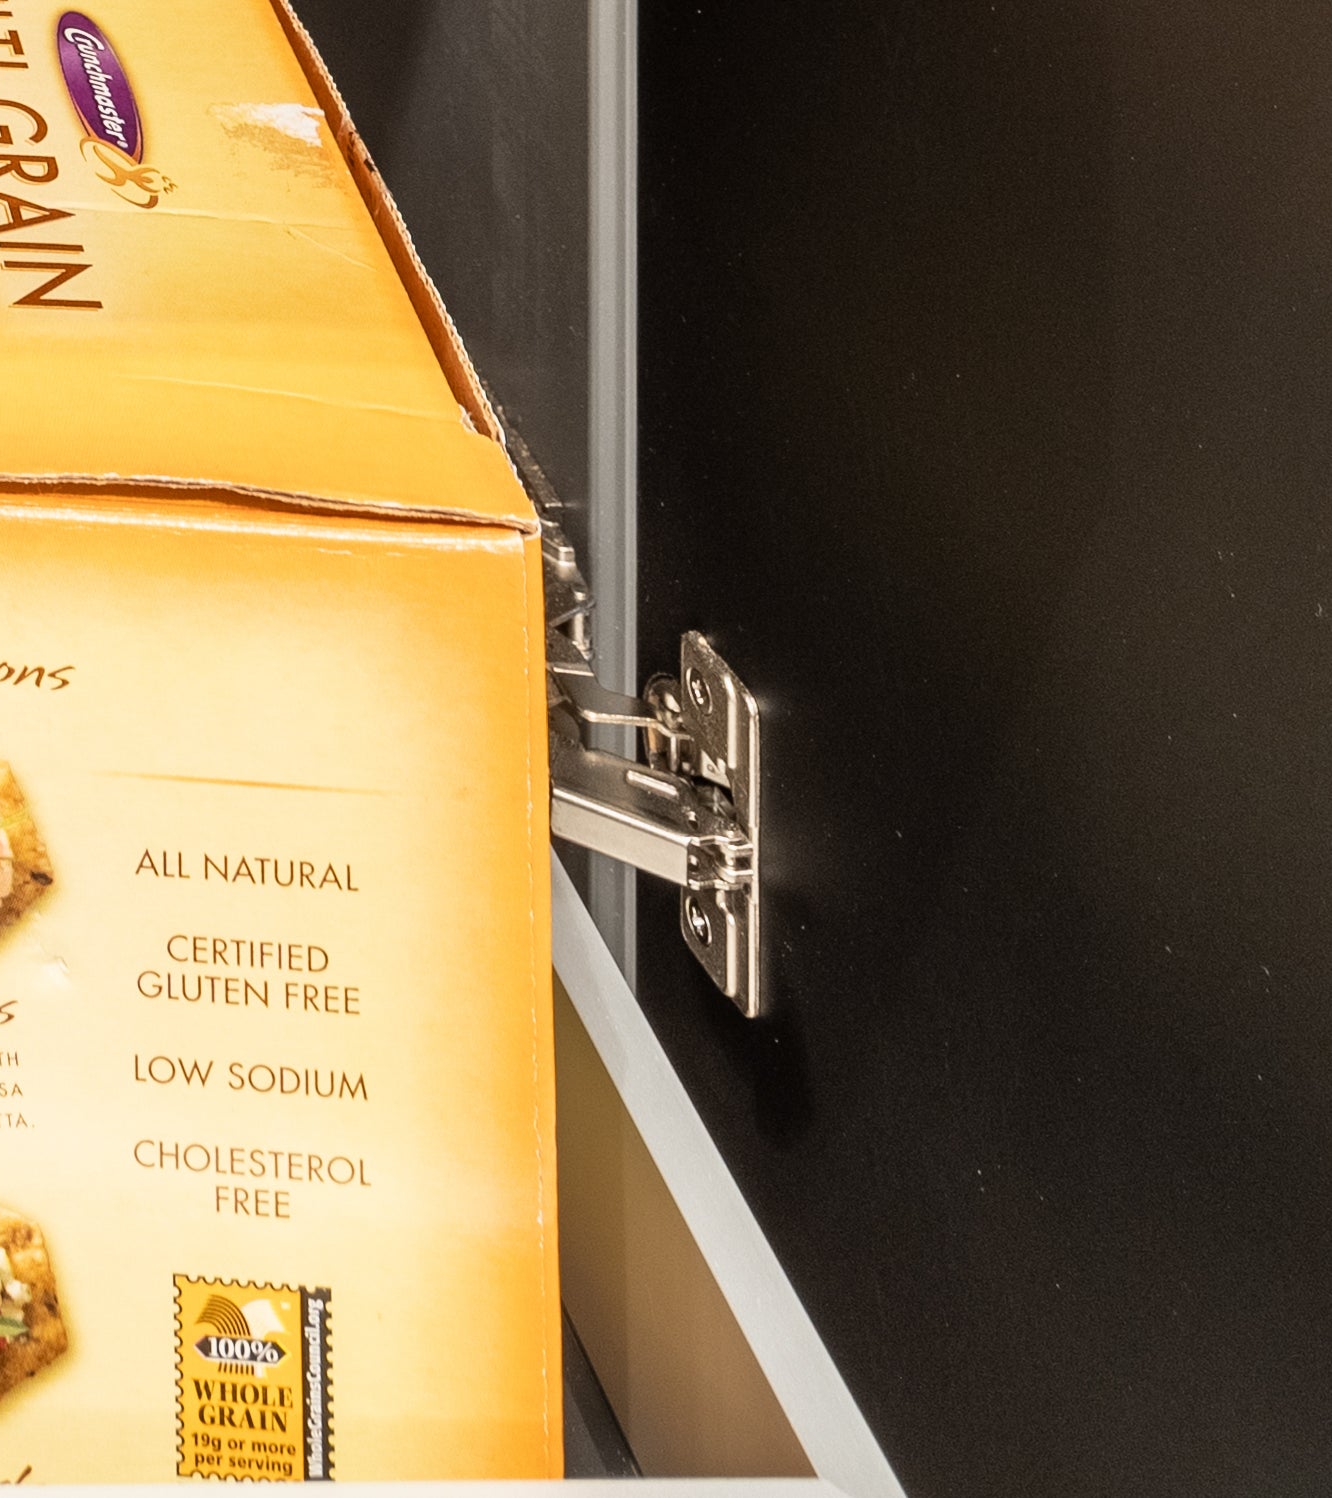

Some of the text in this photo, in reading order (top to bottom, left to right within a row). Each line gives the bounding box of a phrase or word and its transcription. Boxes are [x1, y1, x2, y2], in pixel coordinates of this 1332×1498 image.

[64, 27, 126, 144] Crunchmaster
[134, 848, 360, 893] ALL NATURAL
[166, 934, 330, 973] CERTIFIED
[136, 970, 361, 1016] GLUTEN FREE
[134, 1053, 369, 1102] LOW SODIUM
[134, 1140, 372, 1187] CHOLESTEROL
[215, 1186, 292, 1219] FREE
[208, 1337, 280, 1363] 100%
[192, 1378, 294, 1409] WHOLE
[198, 1404, 287, 1433] GRAIN
[192, 1432, 296, 1455] 19g or more
[194, 1452, 293, 1476] per serving
